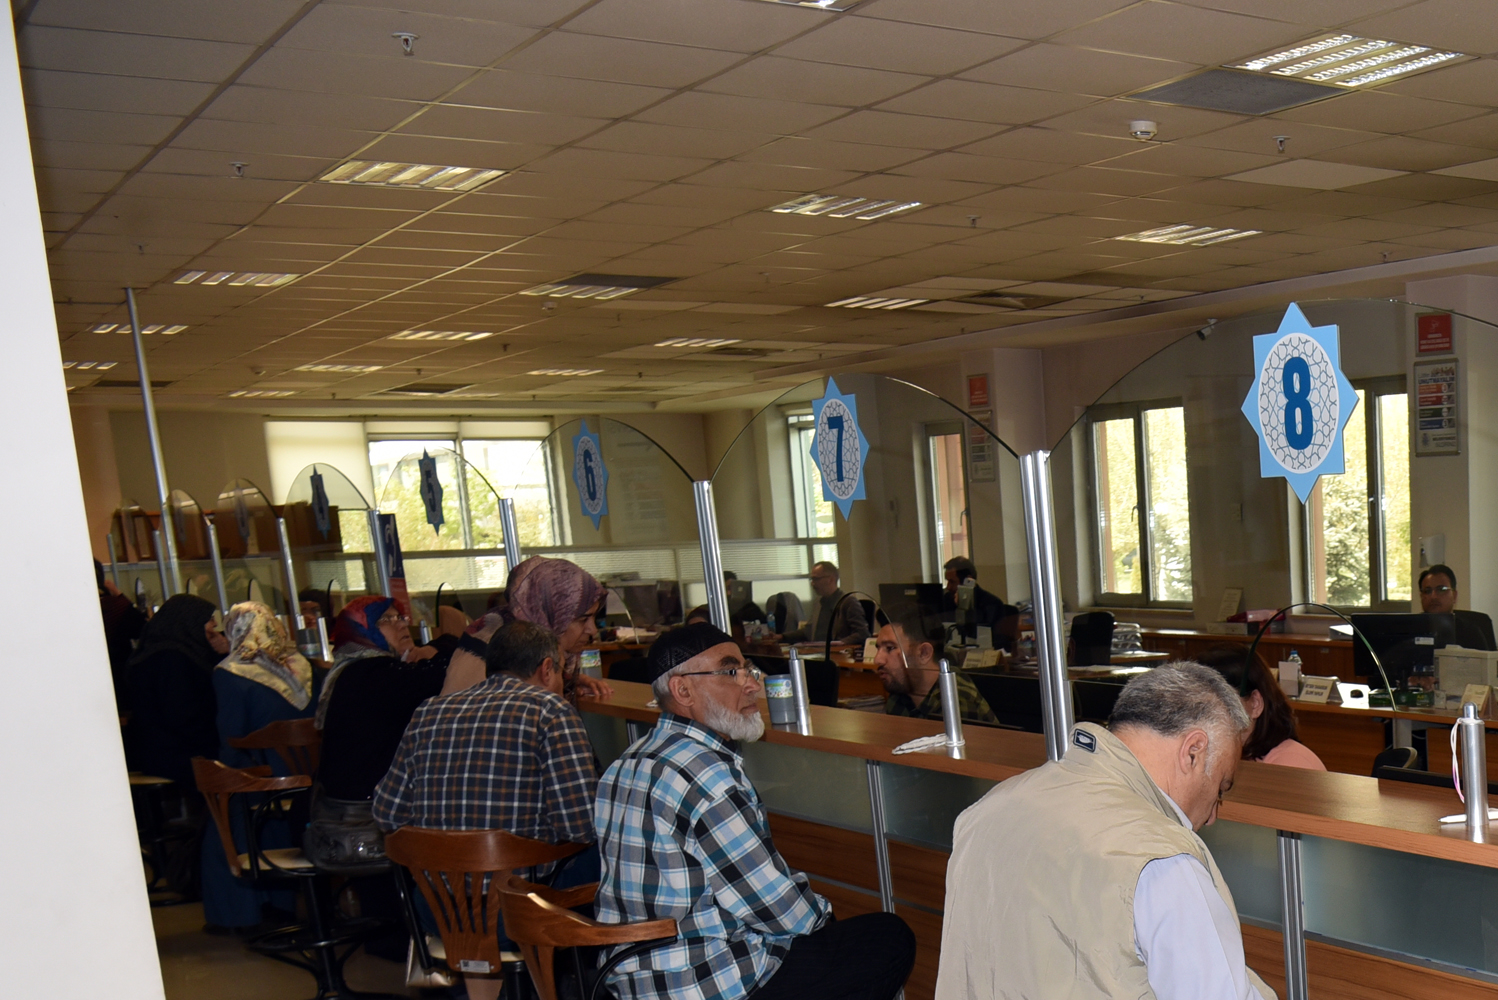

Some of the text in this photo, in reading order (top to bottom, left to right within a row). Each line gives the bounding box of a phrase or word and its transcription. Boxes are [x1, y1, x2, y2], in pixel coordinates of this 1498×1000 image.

[1281, 357, 1313, 451] 8
[583, 449, 596, 501] 6
[827, 416, 845, 483] 7
[425, 470, 436, 512] 5
